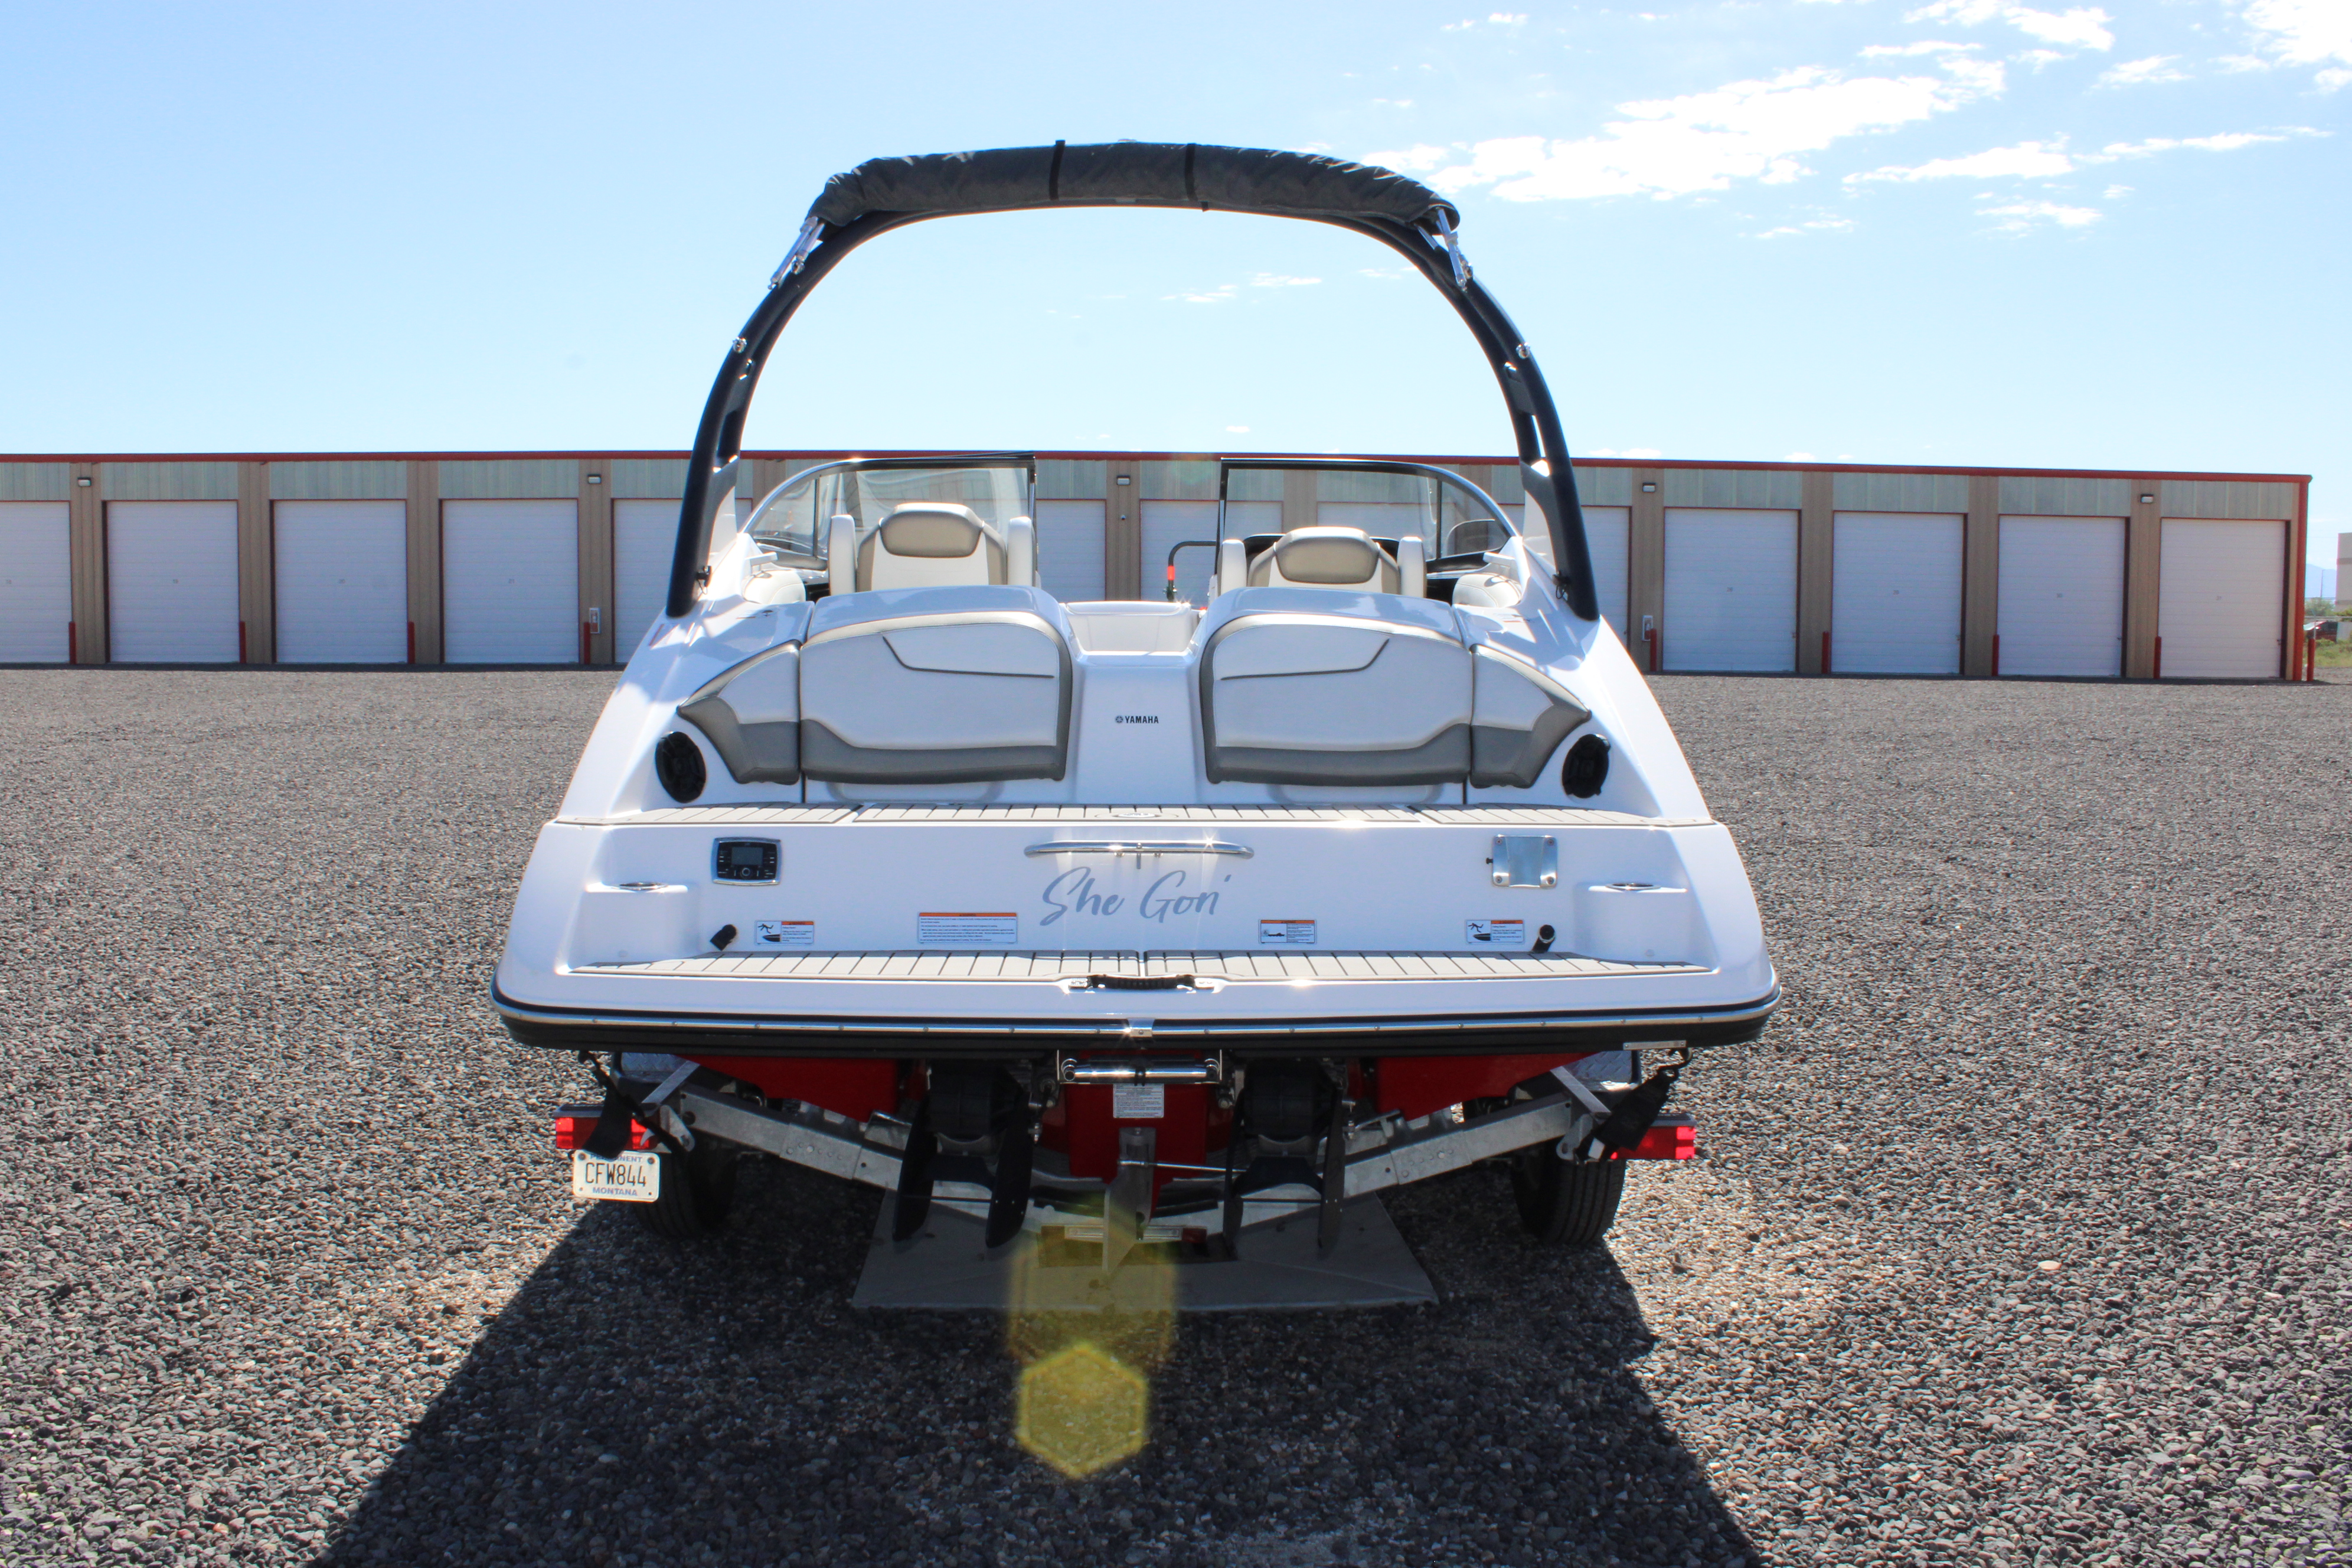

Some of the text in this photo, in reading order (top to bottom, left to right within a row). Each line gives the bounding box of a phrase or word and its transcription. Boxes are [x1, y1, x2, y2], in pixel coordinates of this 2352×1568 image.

[1124, 715, 1159, 724] YAMAHA
[1039, 866, 1232, 926] She Gon'
[586, 1162, 646, 1187] CFW844
[593, 1187, 638, 1195] MONTANA
